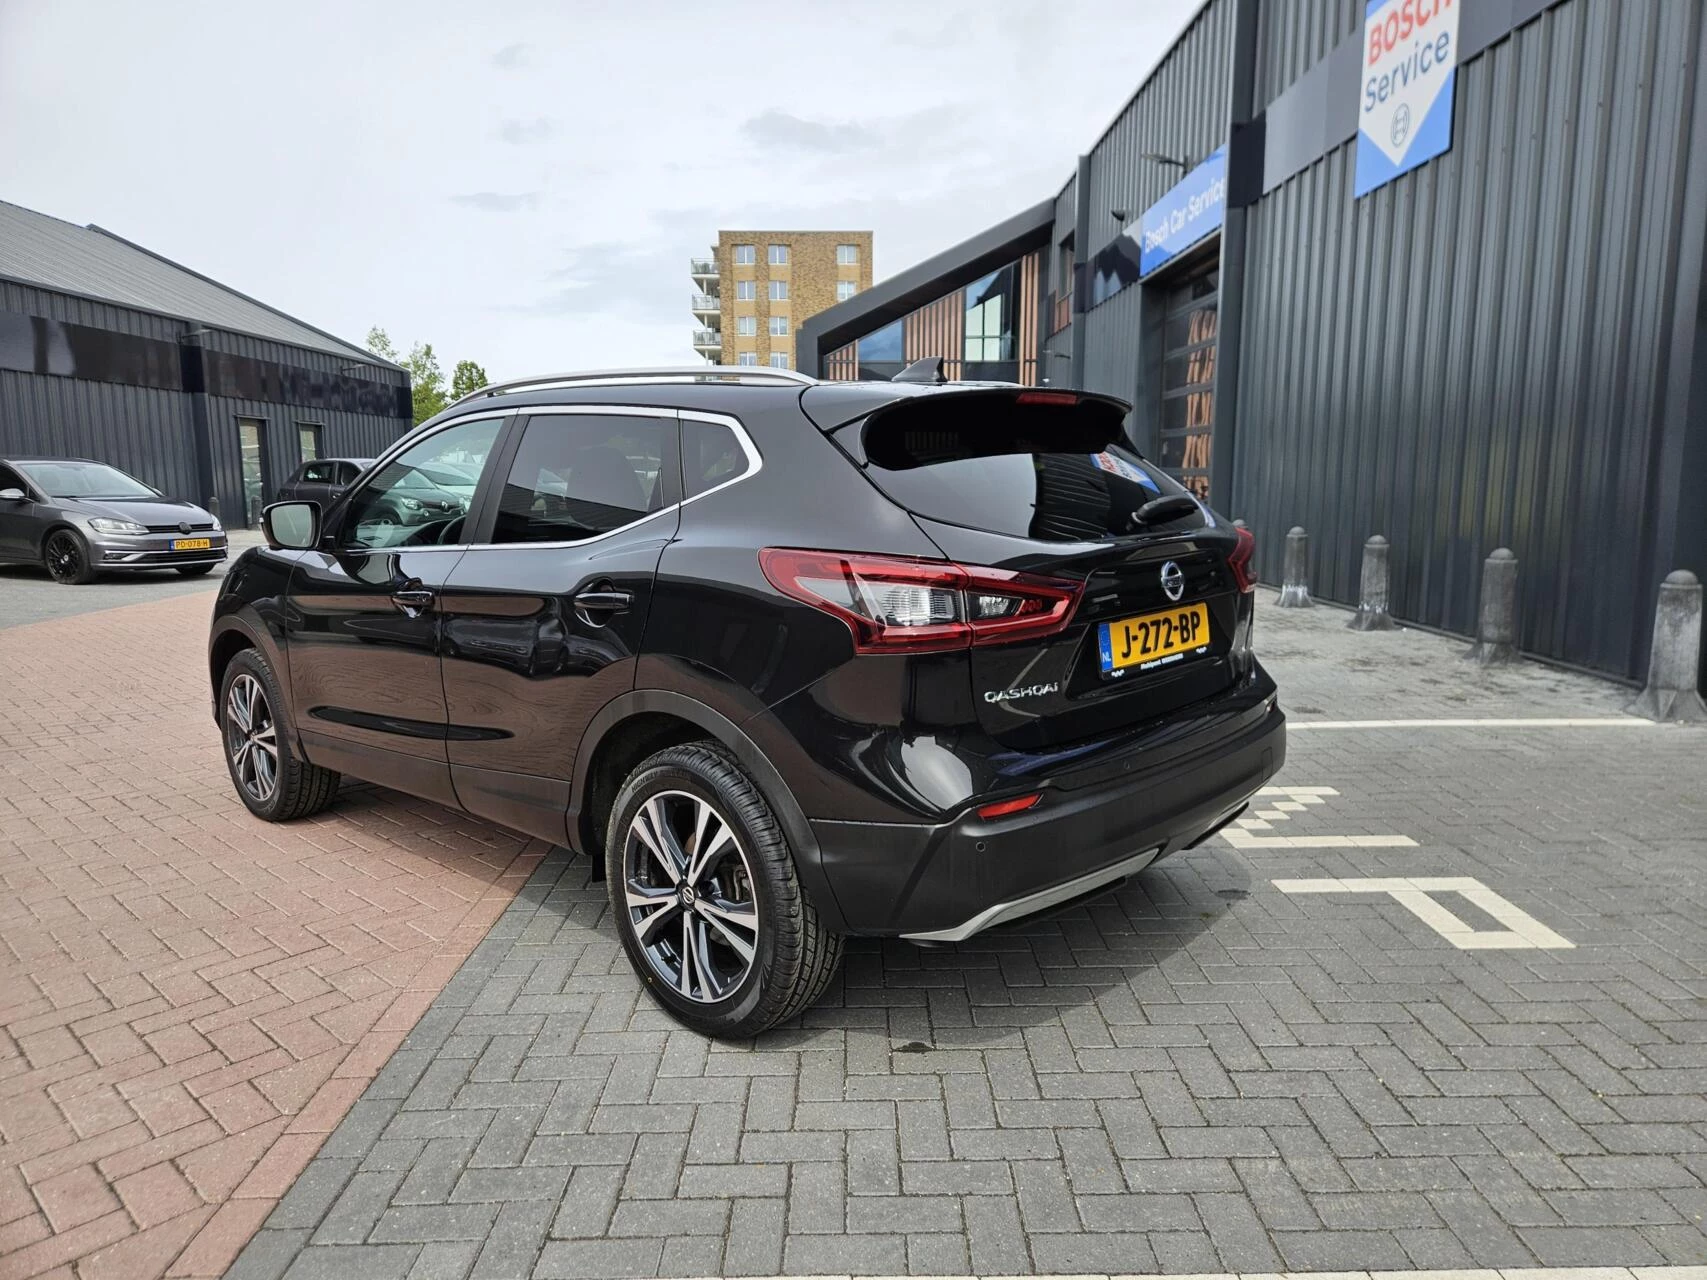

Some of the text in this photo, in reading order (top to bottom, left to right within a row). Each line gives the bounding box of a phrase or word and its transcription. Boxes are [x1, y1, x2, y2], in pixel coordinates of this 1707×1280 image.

[1365, 31, 1450, 112] Service
[1145, 218, 1169, 254] Bosch
[1170, 208, 1188, 234] Car
[1102, 651, 1112, 663] NL
[1121, 611, 1201, 659] J-272-BP
